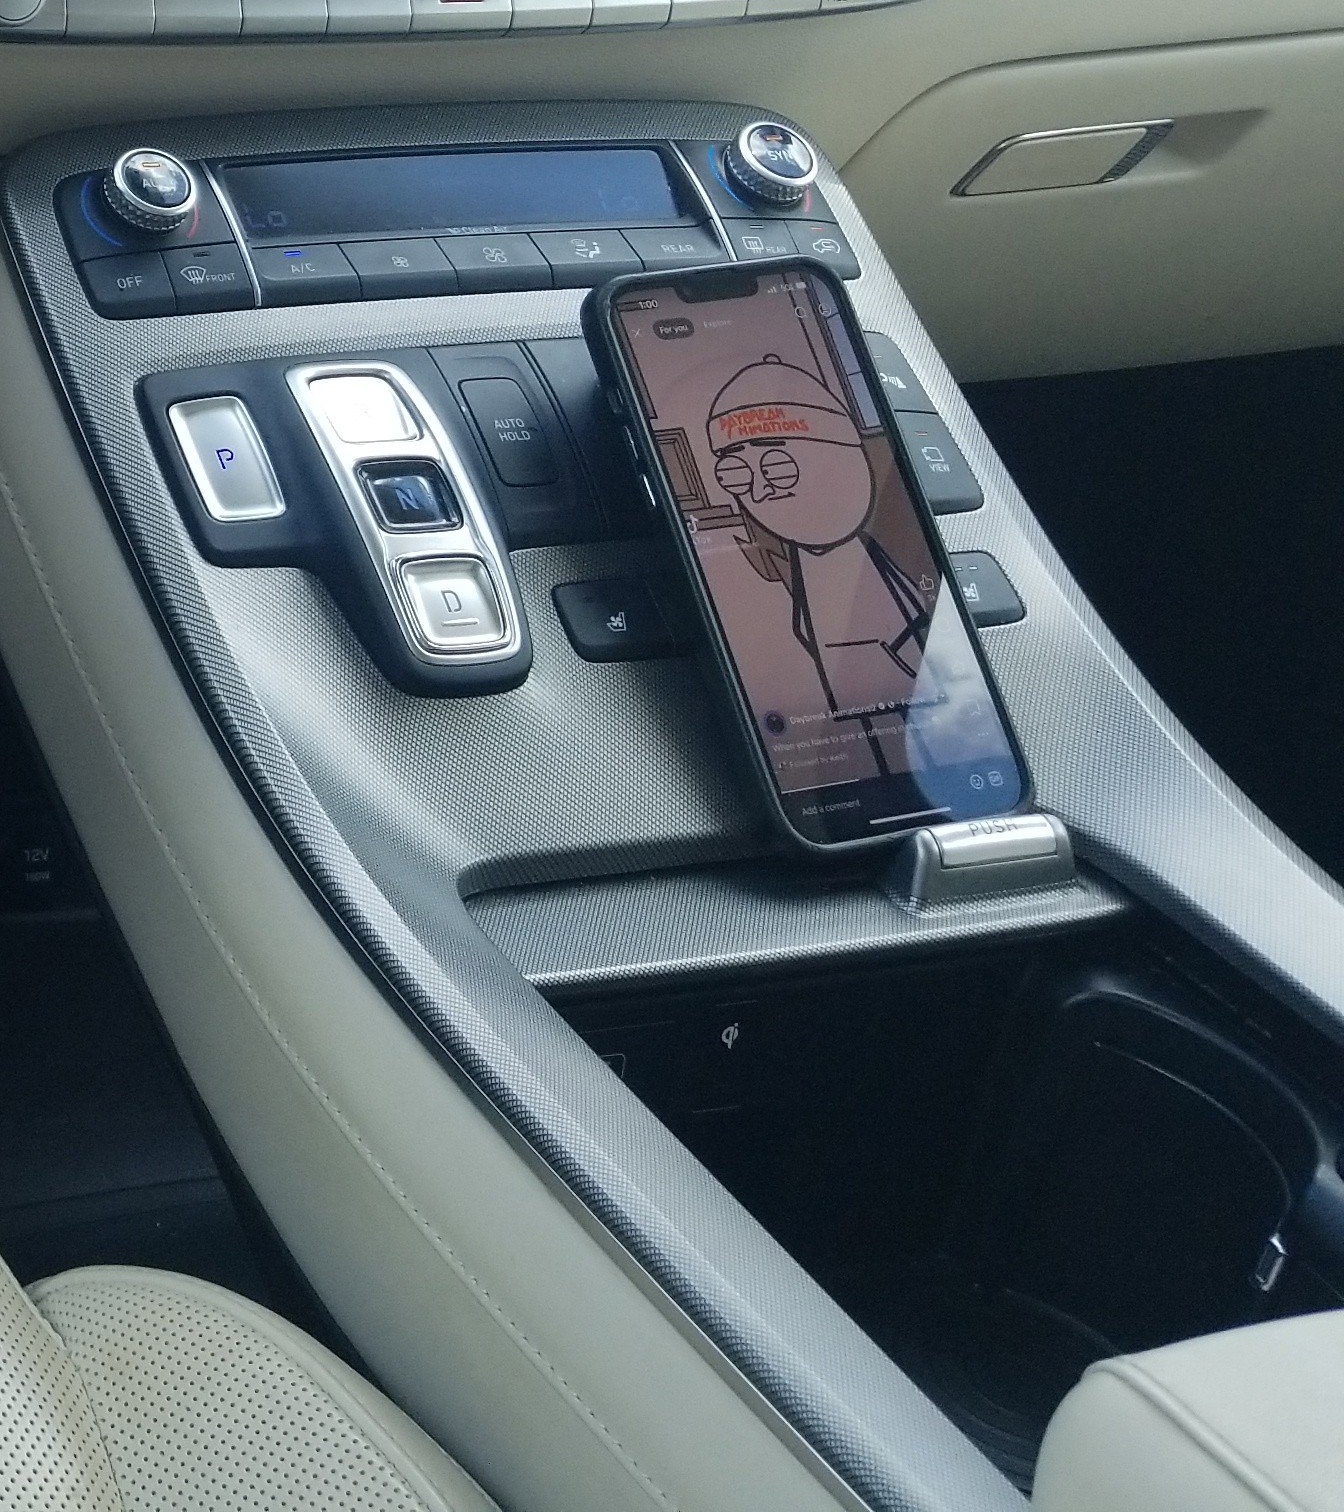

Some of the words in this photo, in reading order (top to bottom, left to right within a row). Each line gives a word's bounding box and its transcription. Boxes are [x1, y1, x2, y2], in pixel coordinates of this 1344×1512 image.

[661, 245, 694, 253] REAR
[291, 262, 315, 273] A/C
[117, 275, 143, 289] OFF
[205, 272, 235, 283] FRONT
[638, 300, 658, 310] 1:00
[659, 326, 673, 334] For
[674, 325, 688, 334] you
[495, 418, 525, 430] AUTO
[499, 429, 531, 442] HOLD
[215, 448, 235, 470] P
[929, 460, 951, 473] VIEW
[442, 590, 462, 613] D
[802, 807, 818, 816] Add
[968, 819, 1019, 837] PUSH
[24, 848, 49, 862] 12V
